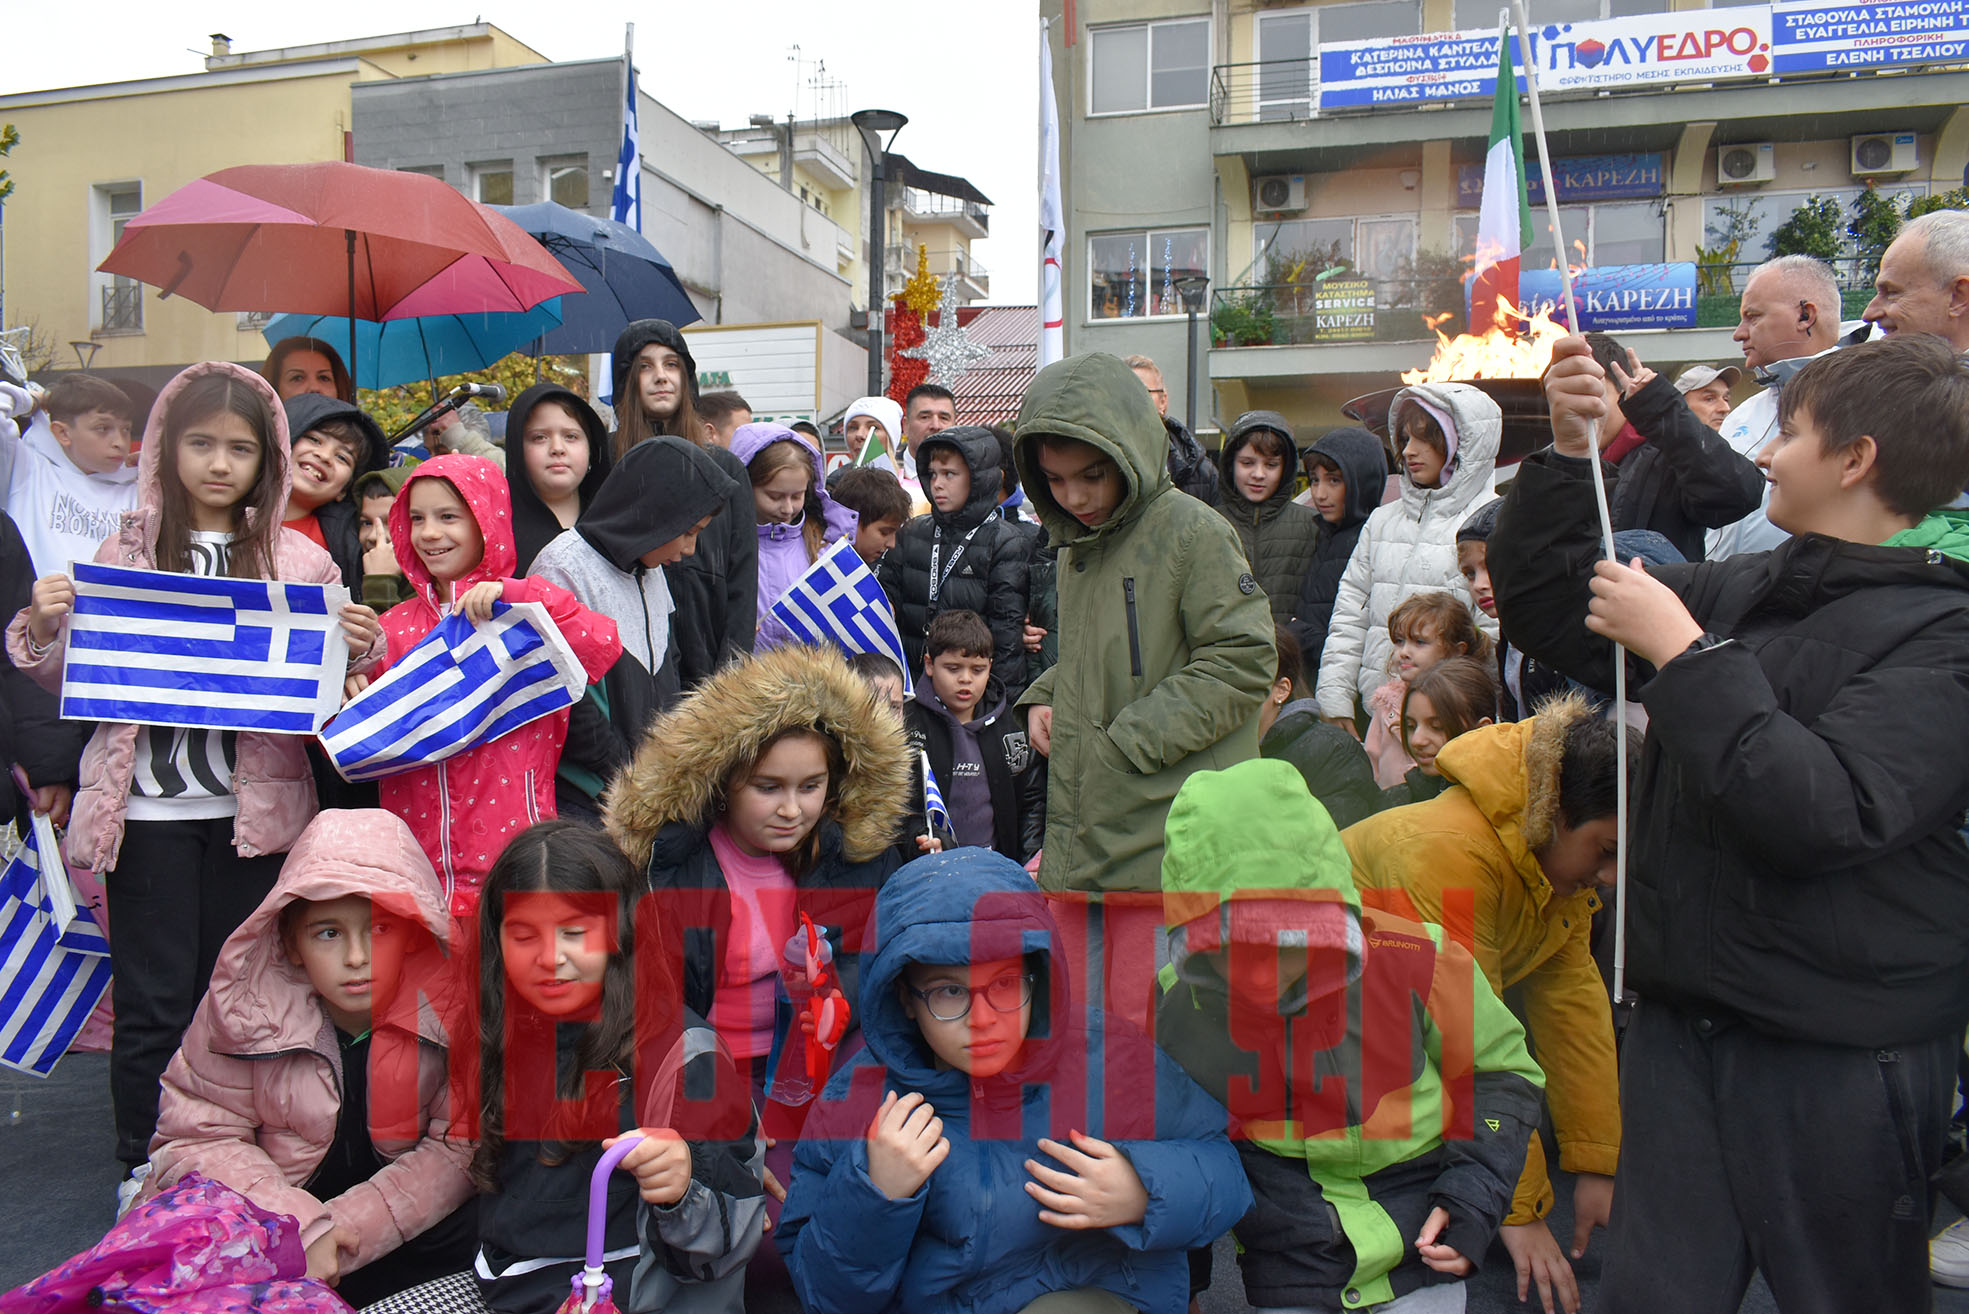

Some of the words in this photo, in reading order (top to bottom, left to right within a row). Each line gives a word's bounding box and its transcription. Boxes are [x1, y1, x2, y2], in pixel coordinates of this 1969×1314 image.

[1785, 9, 1870, 28] ΣΤΑΘΟΥΛΑ
[1875, 1, 1962, 19] ΣΤΑΜΟΥΛΗ
[1795, 22, 1888, 40] ΕΥΑΓΓΕΛΙΑ
[1890, 15, 1954, 32] ΕΙΡΗΝΗ
[1854, 33, 1944, 47] ΠΛΗΡΟΦΟΡΙΚΗ
[1350, 47, 1425, 65] ΚΑΤΕΡΙΝΑ
[1826, 50, 1884, 65] ΕΛΕΝΗ
[1890, 43, 1966, 60] ΤΣΕΛΙΟΥ
[1354, 59, 1432, 76] ΔΕΣΠΟΙΝΑ
[1636, 69, 1669, 79] ΜΕΣΗΣ
[1674, 63, 1743, 76] ΕΚΠΑΙΔΕΥΣΗΣ
[1372, 86, 1419, 102] ΗΛΙΑΣ
[1424, 81, 1480, 97] ΜΑΝΟΣ
[1564, 168, 1657, 188] ΚΑΡΕΖΗ
[1322, 280, 1368, 290] ΜΟΥΣΙΚΟ
[1315, 289, 1375, 299] ΚΑΤΑΣΤΗΜΑ
[1585, 288, 1692, 312] ΚΑΡΕΖΗ
[1315, 297, 1375, 309] SERVICE
[1316, 313, 1374, 328] ΚΑΡΕΖΗ
[1382, 940, 1421, 951] BRUNOTTI
